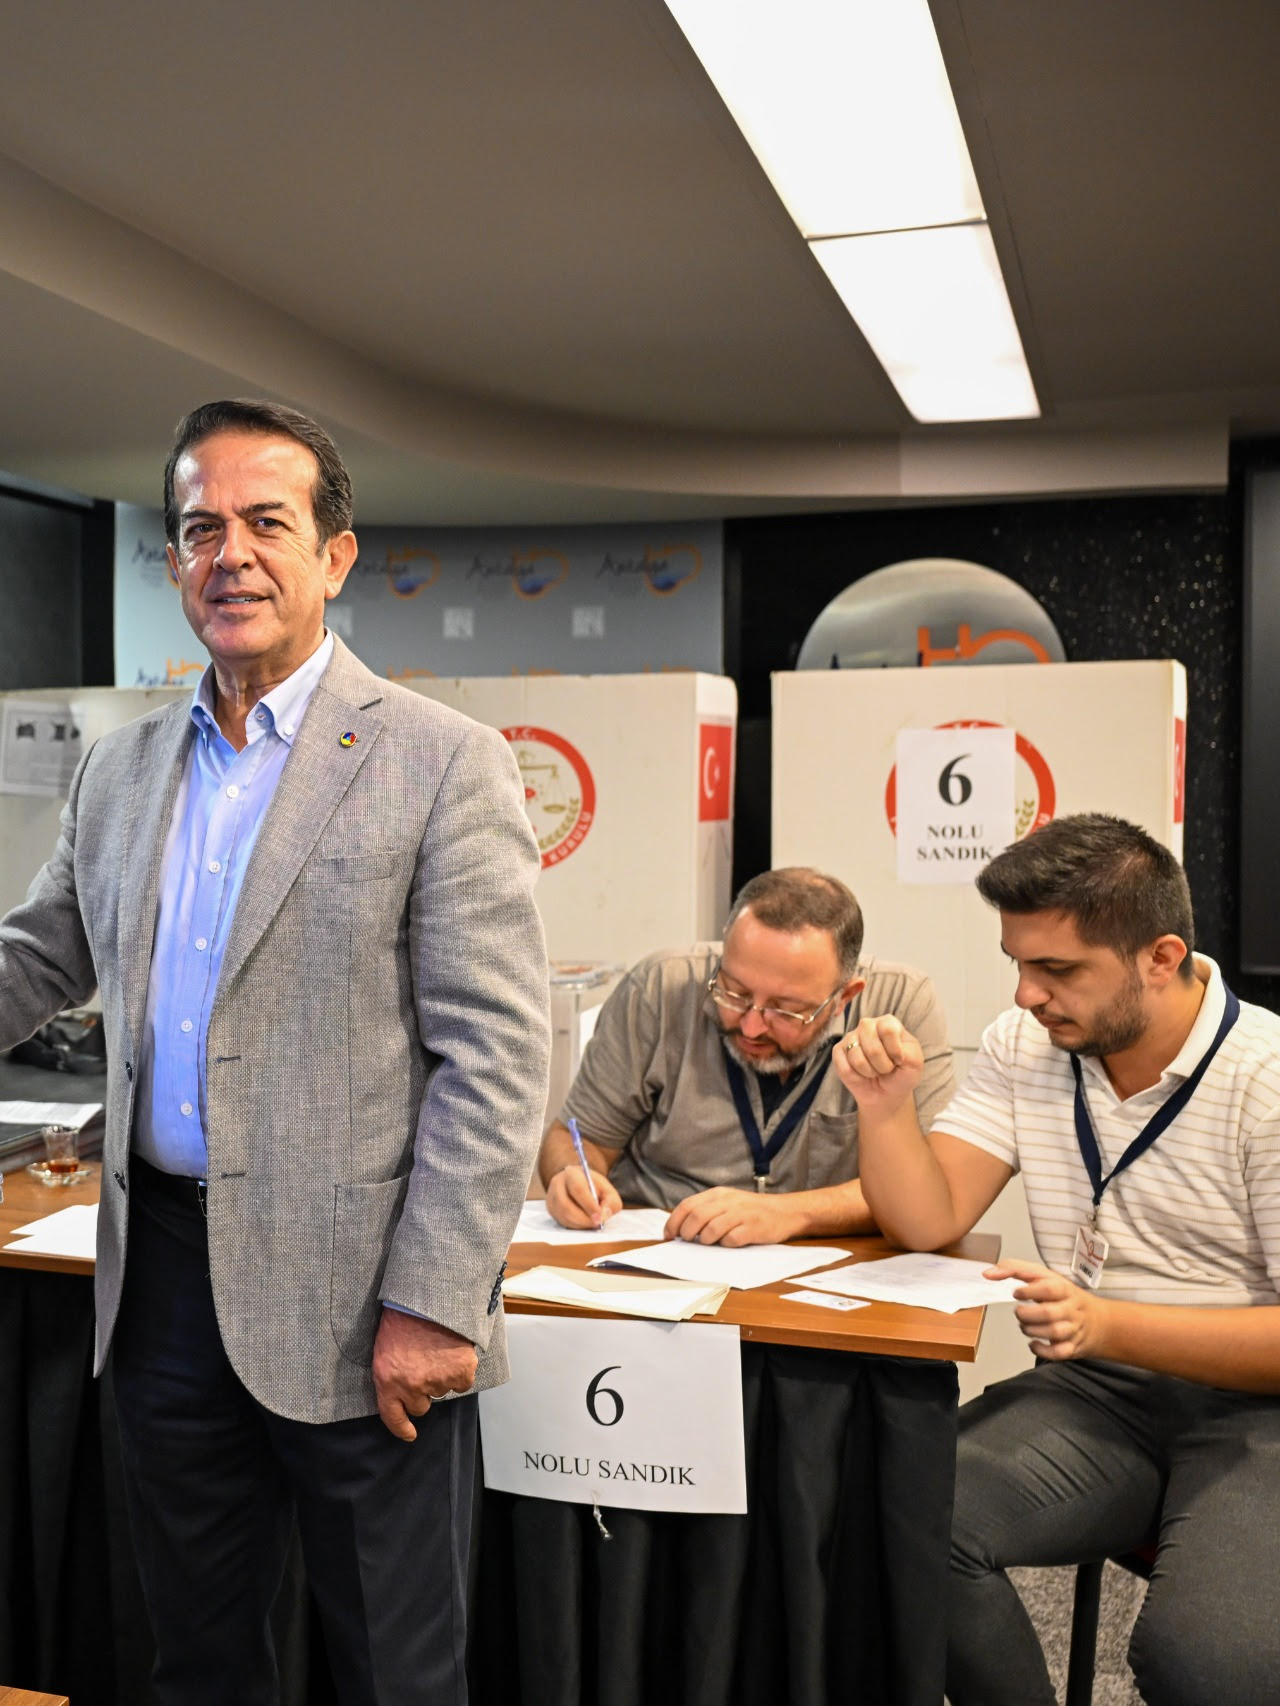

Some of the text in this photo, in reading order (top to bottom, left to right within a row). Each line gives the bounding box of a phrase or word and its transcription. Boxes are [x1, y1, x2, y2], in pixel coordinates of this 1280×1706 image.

[938, 753, 972, 806] 6
[927, 824, 983, 840] NOLU
[916, 846, 993, 862] SANDIK
[586, 1366, 625, 1427] 6
[522, 1450, 697, 1486] NOLU SANDIK
